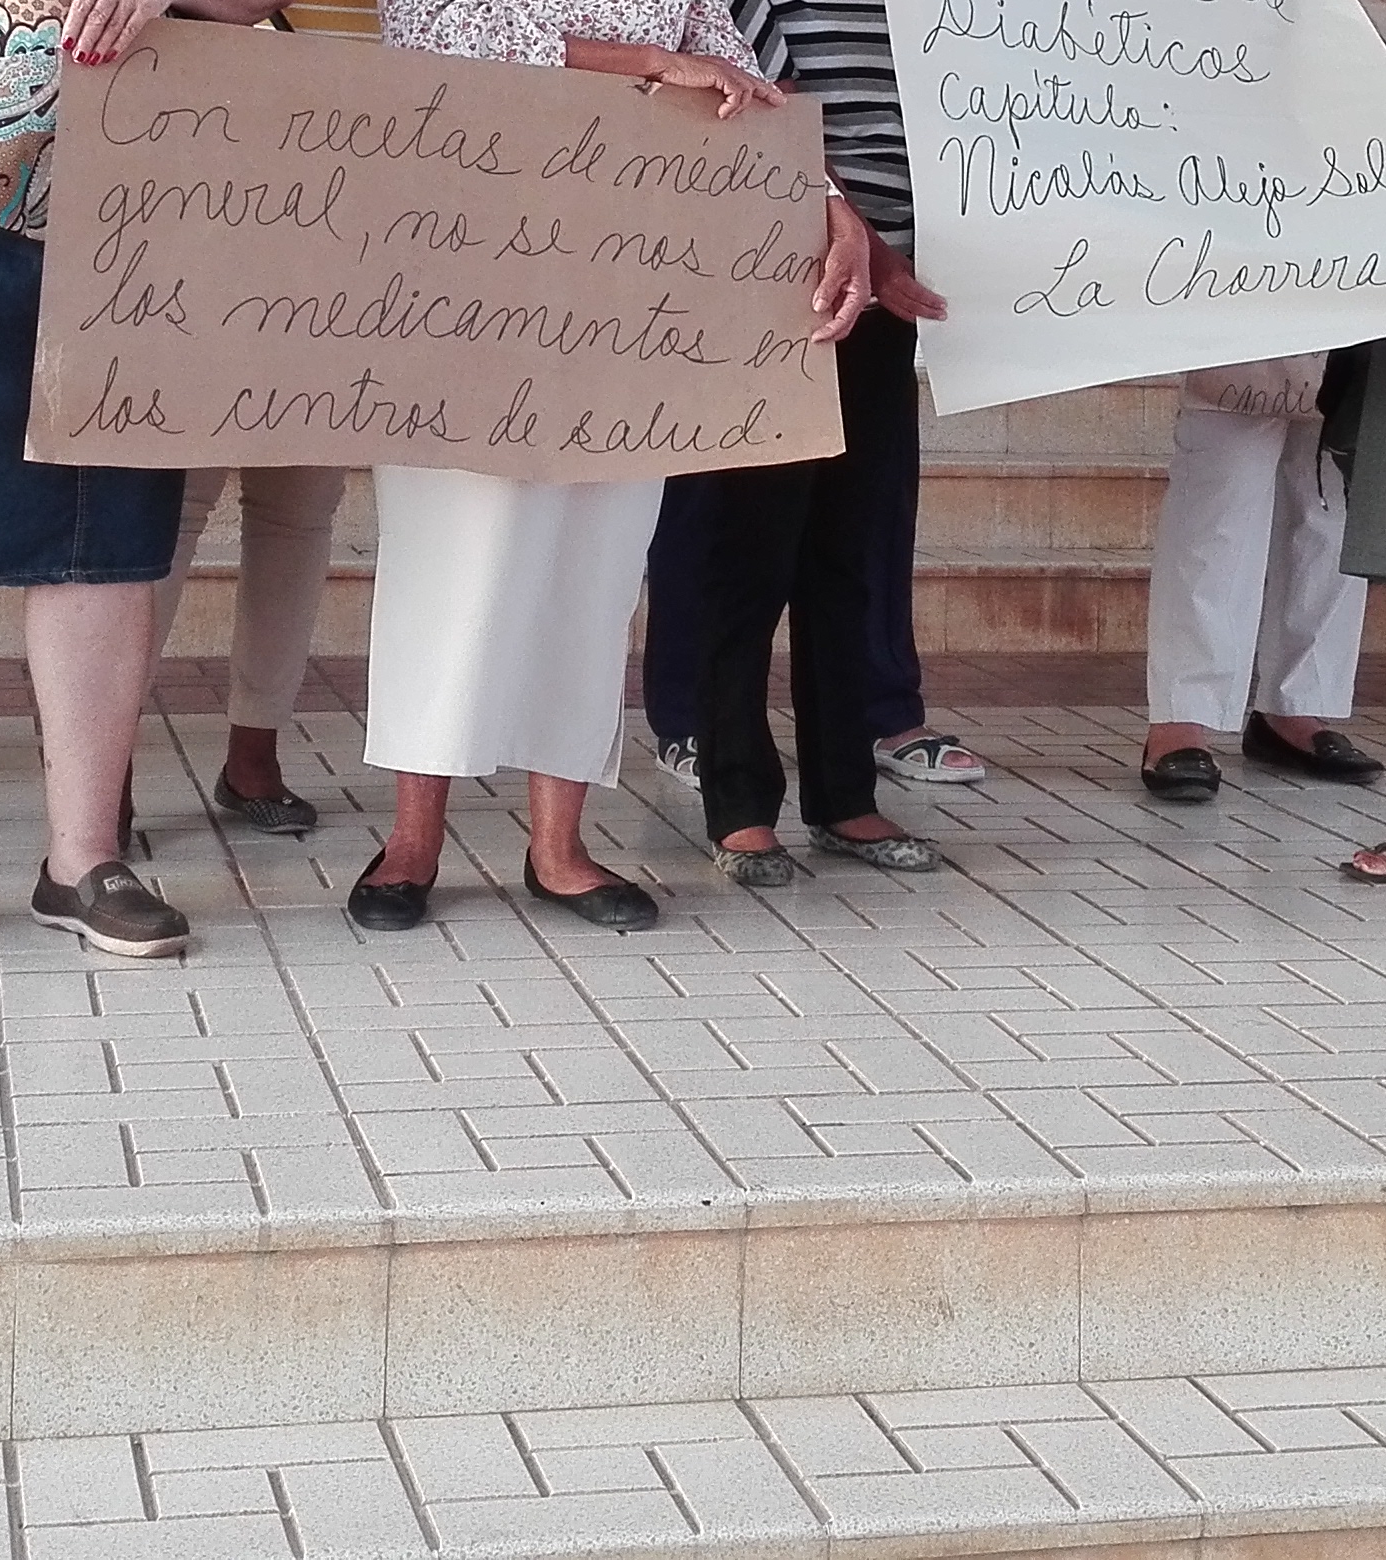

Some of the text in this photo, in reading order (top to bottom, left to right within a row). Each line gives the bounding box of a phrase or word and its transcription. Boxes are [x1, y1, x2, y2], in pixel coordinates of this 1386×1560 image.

[100, 45, 829, 204] Con recetas de médico
[92, 164, 824, 286] general, no se nos dan
[938, 134, 1166, 217] Nicolás
[1178, 154, 1308, 239] Alejo
[78, 239, 816, 383] los medicamentos en
[1012, 238, 1116, 318] La
[68, 355, 785, 455] los centros de salud.
[1218, 377, 1318, 416] candi
